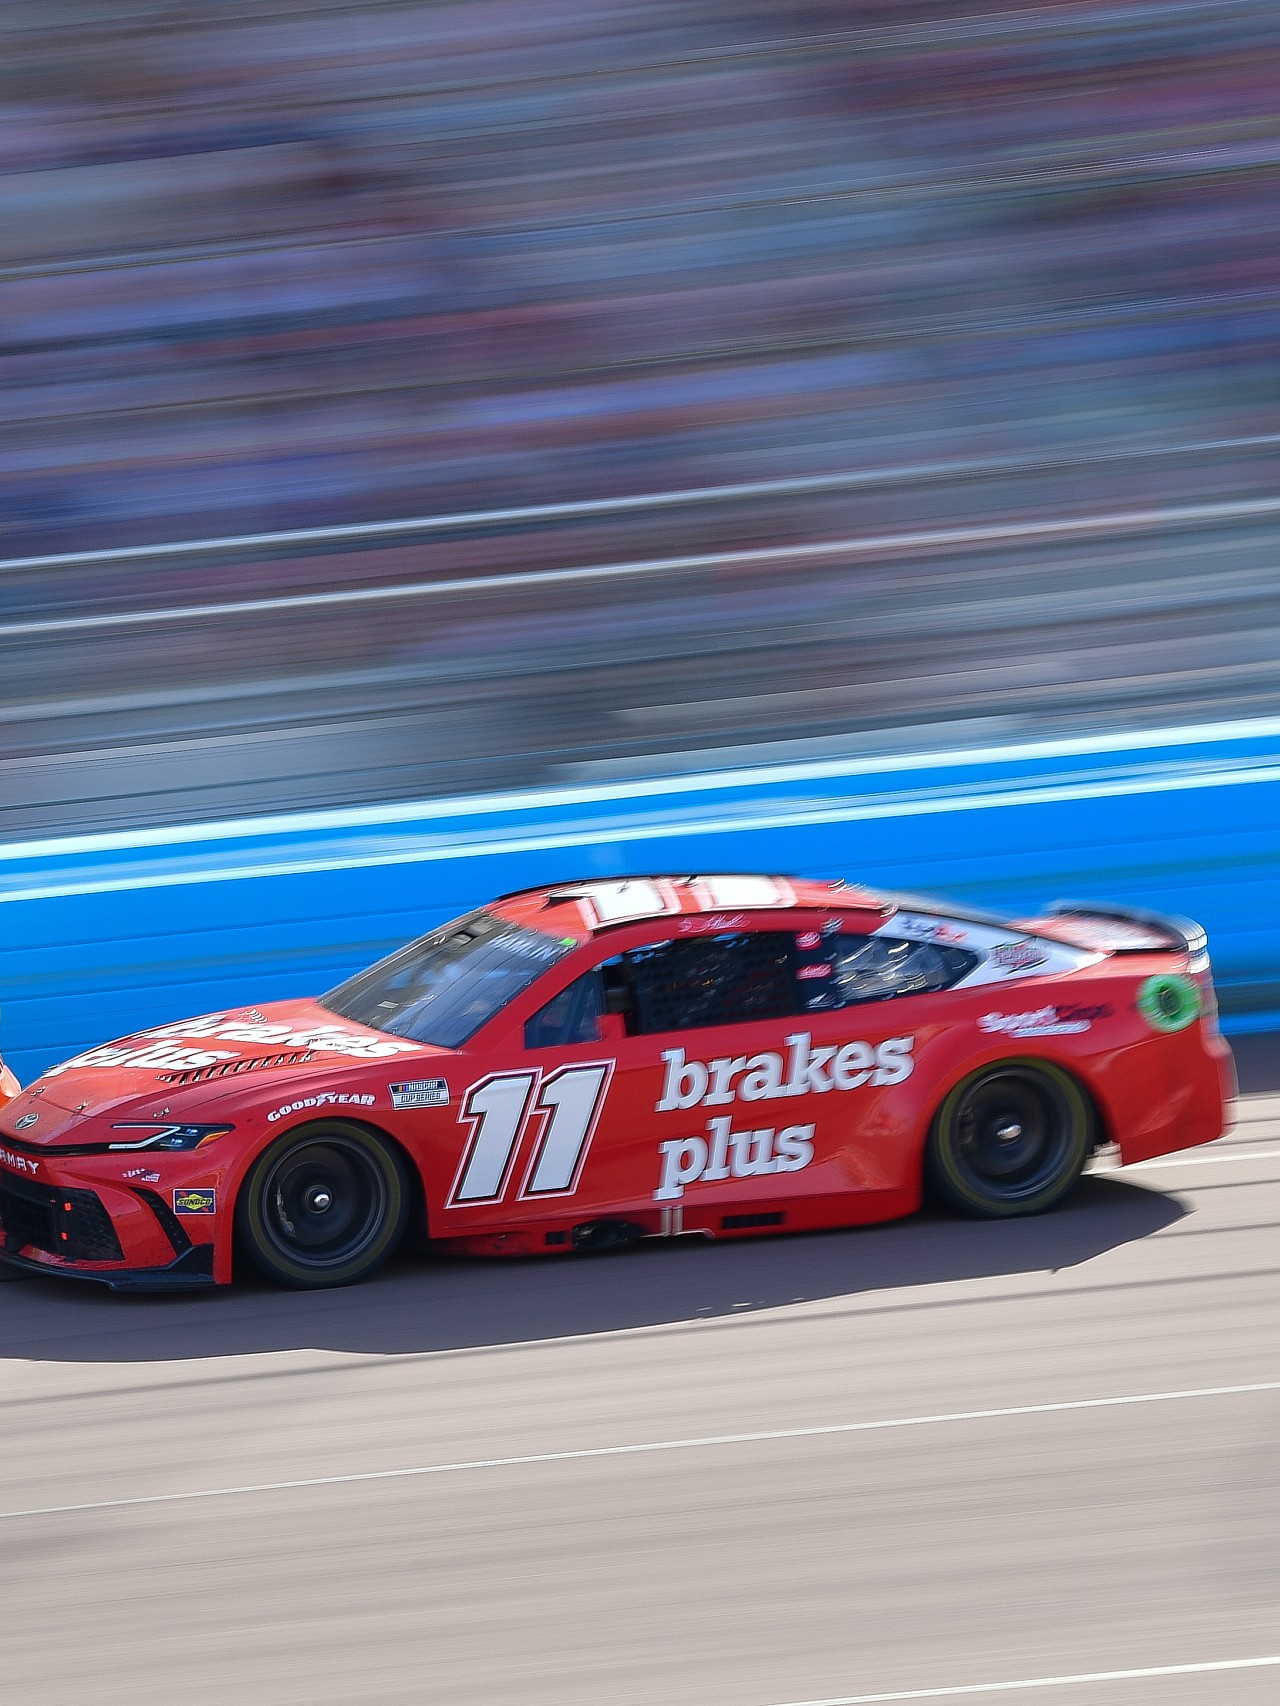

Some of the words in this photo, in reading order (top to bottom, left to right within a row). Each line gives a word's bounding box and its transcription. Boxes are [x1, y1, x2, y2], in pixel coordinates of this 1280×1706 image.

[267, 1091, 376, 1122] GOODYEAR
[655, 1031, 915, 1112] brakes
[444, 1058, 616, 1209] 11
[652, 1115, 816, 1201] plus
[178, 1198, 212, 1206] SUNOCO
